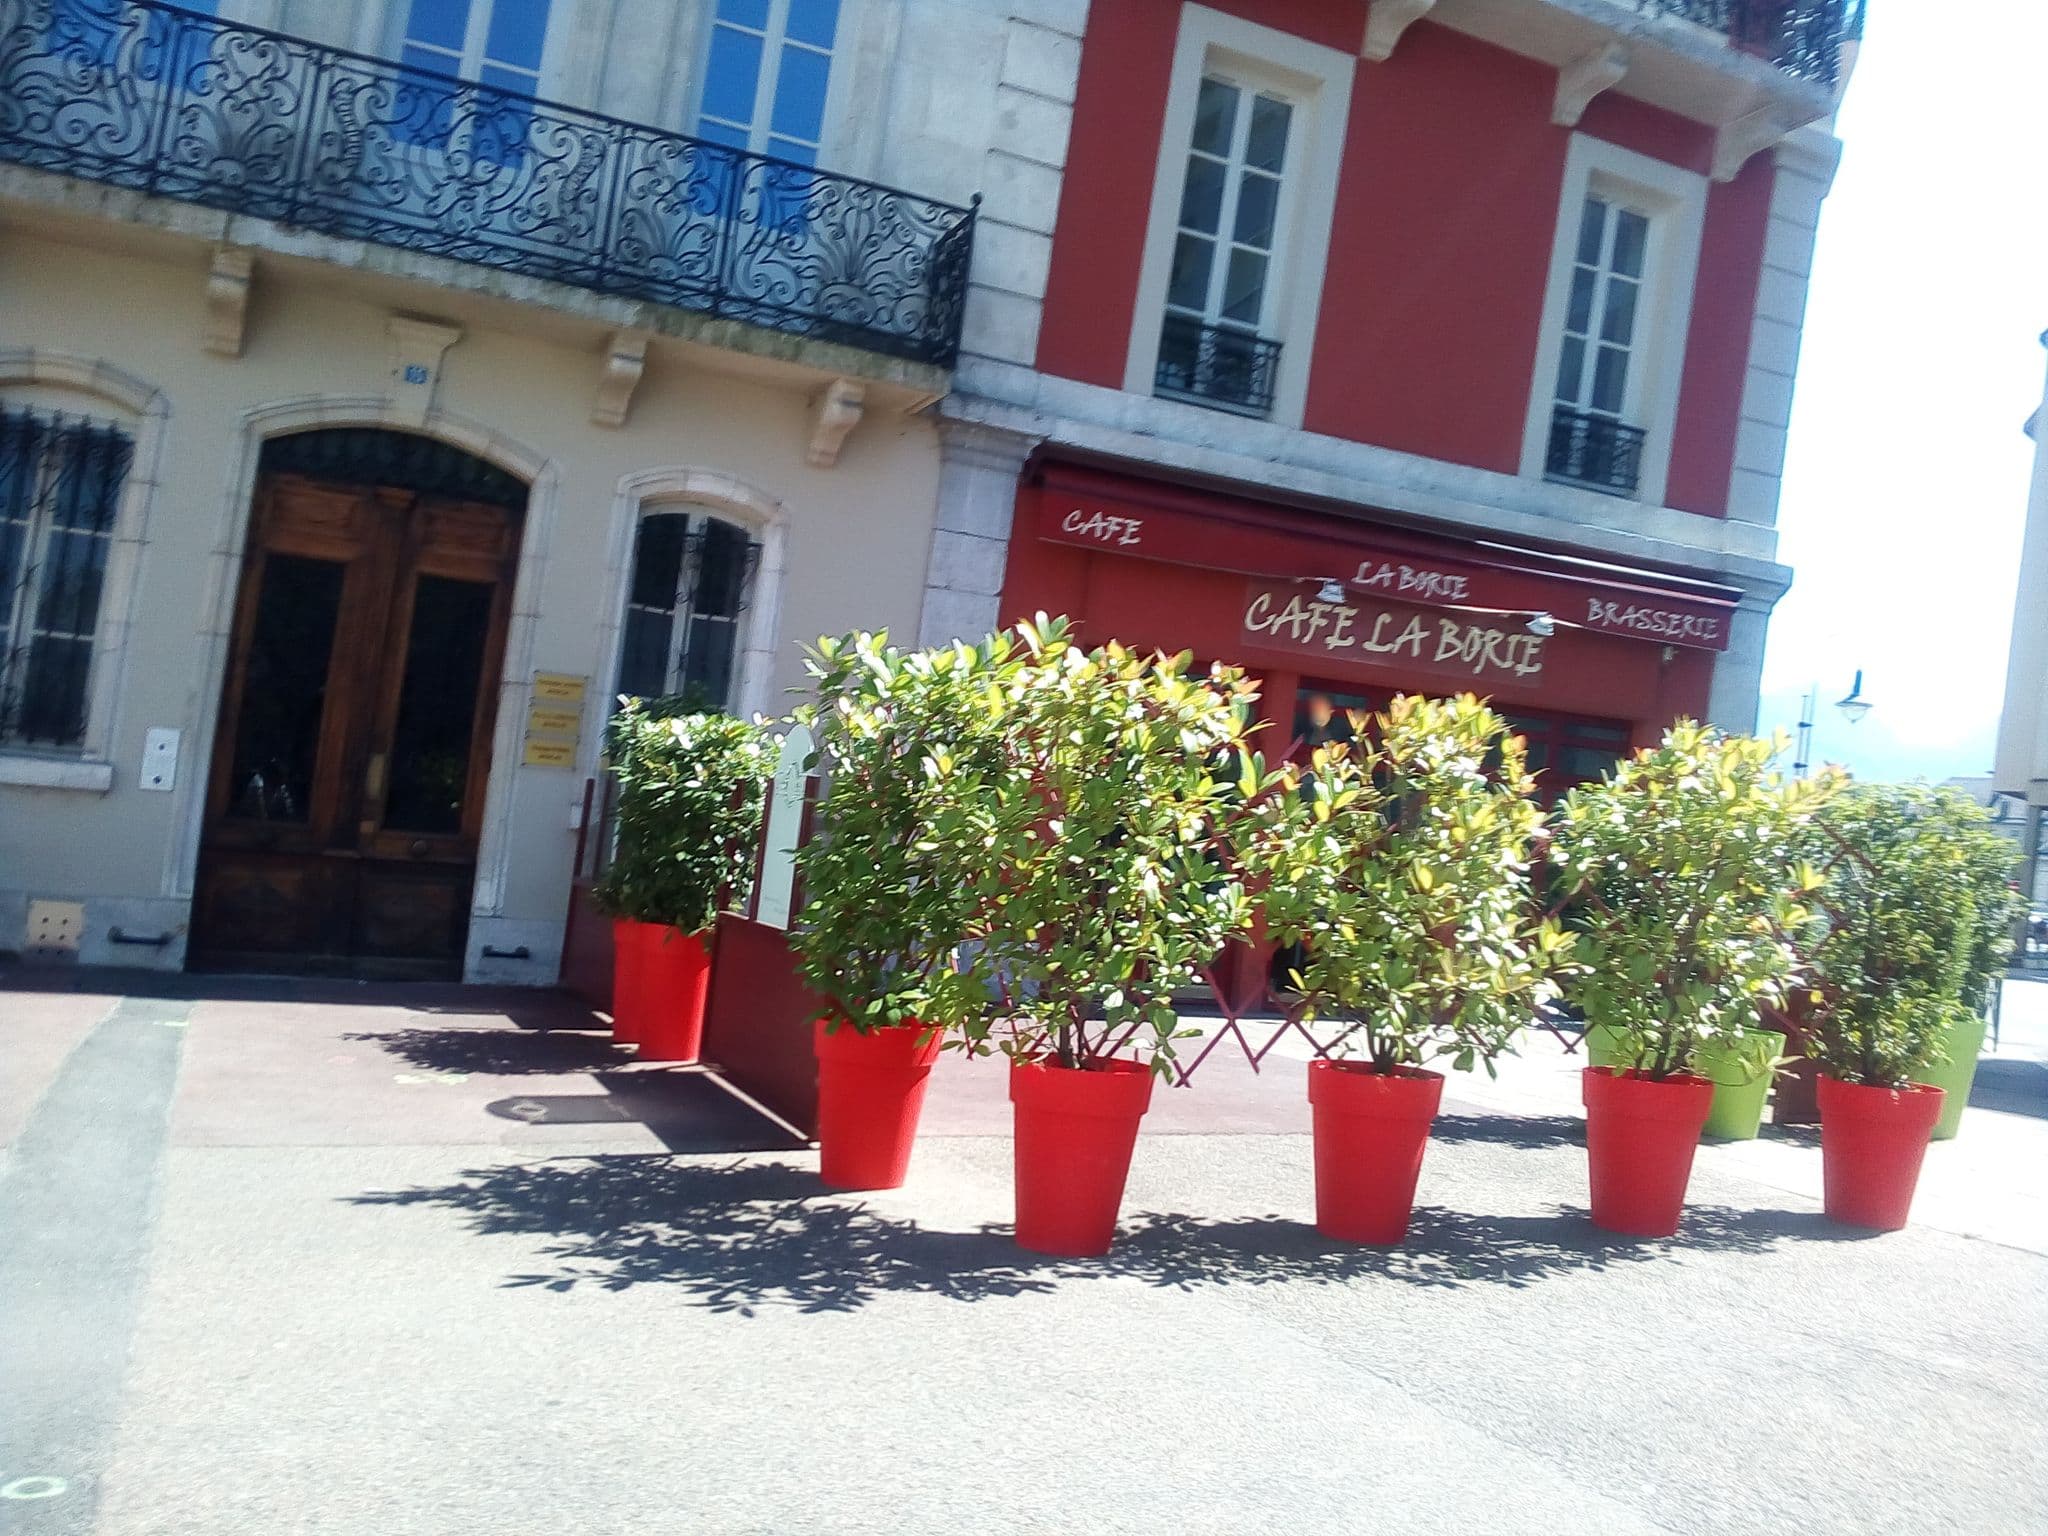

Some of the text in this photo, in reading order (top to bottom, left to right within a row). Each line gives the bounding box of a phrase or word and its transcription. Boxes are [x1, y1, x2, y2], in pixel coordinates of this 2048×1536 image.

[1061, 509, 1720, 640] CAFE LA BORIE BRASSERIE
[1244, 592, 1545, 677] CAFE LA BORIE
